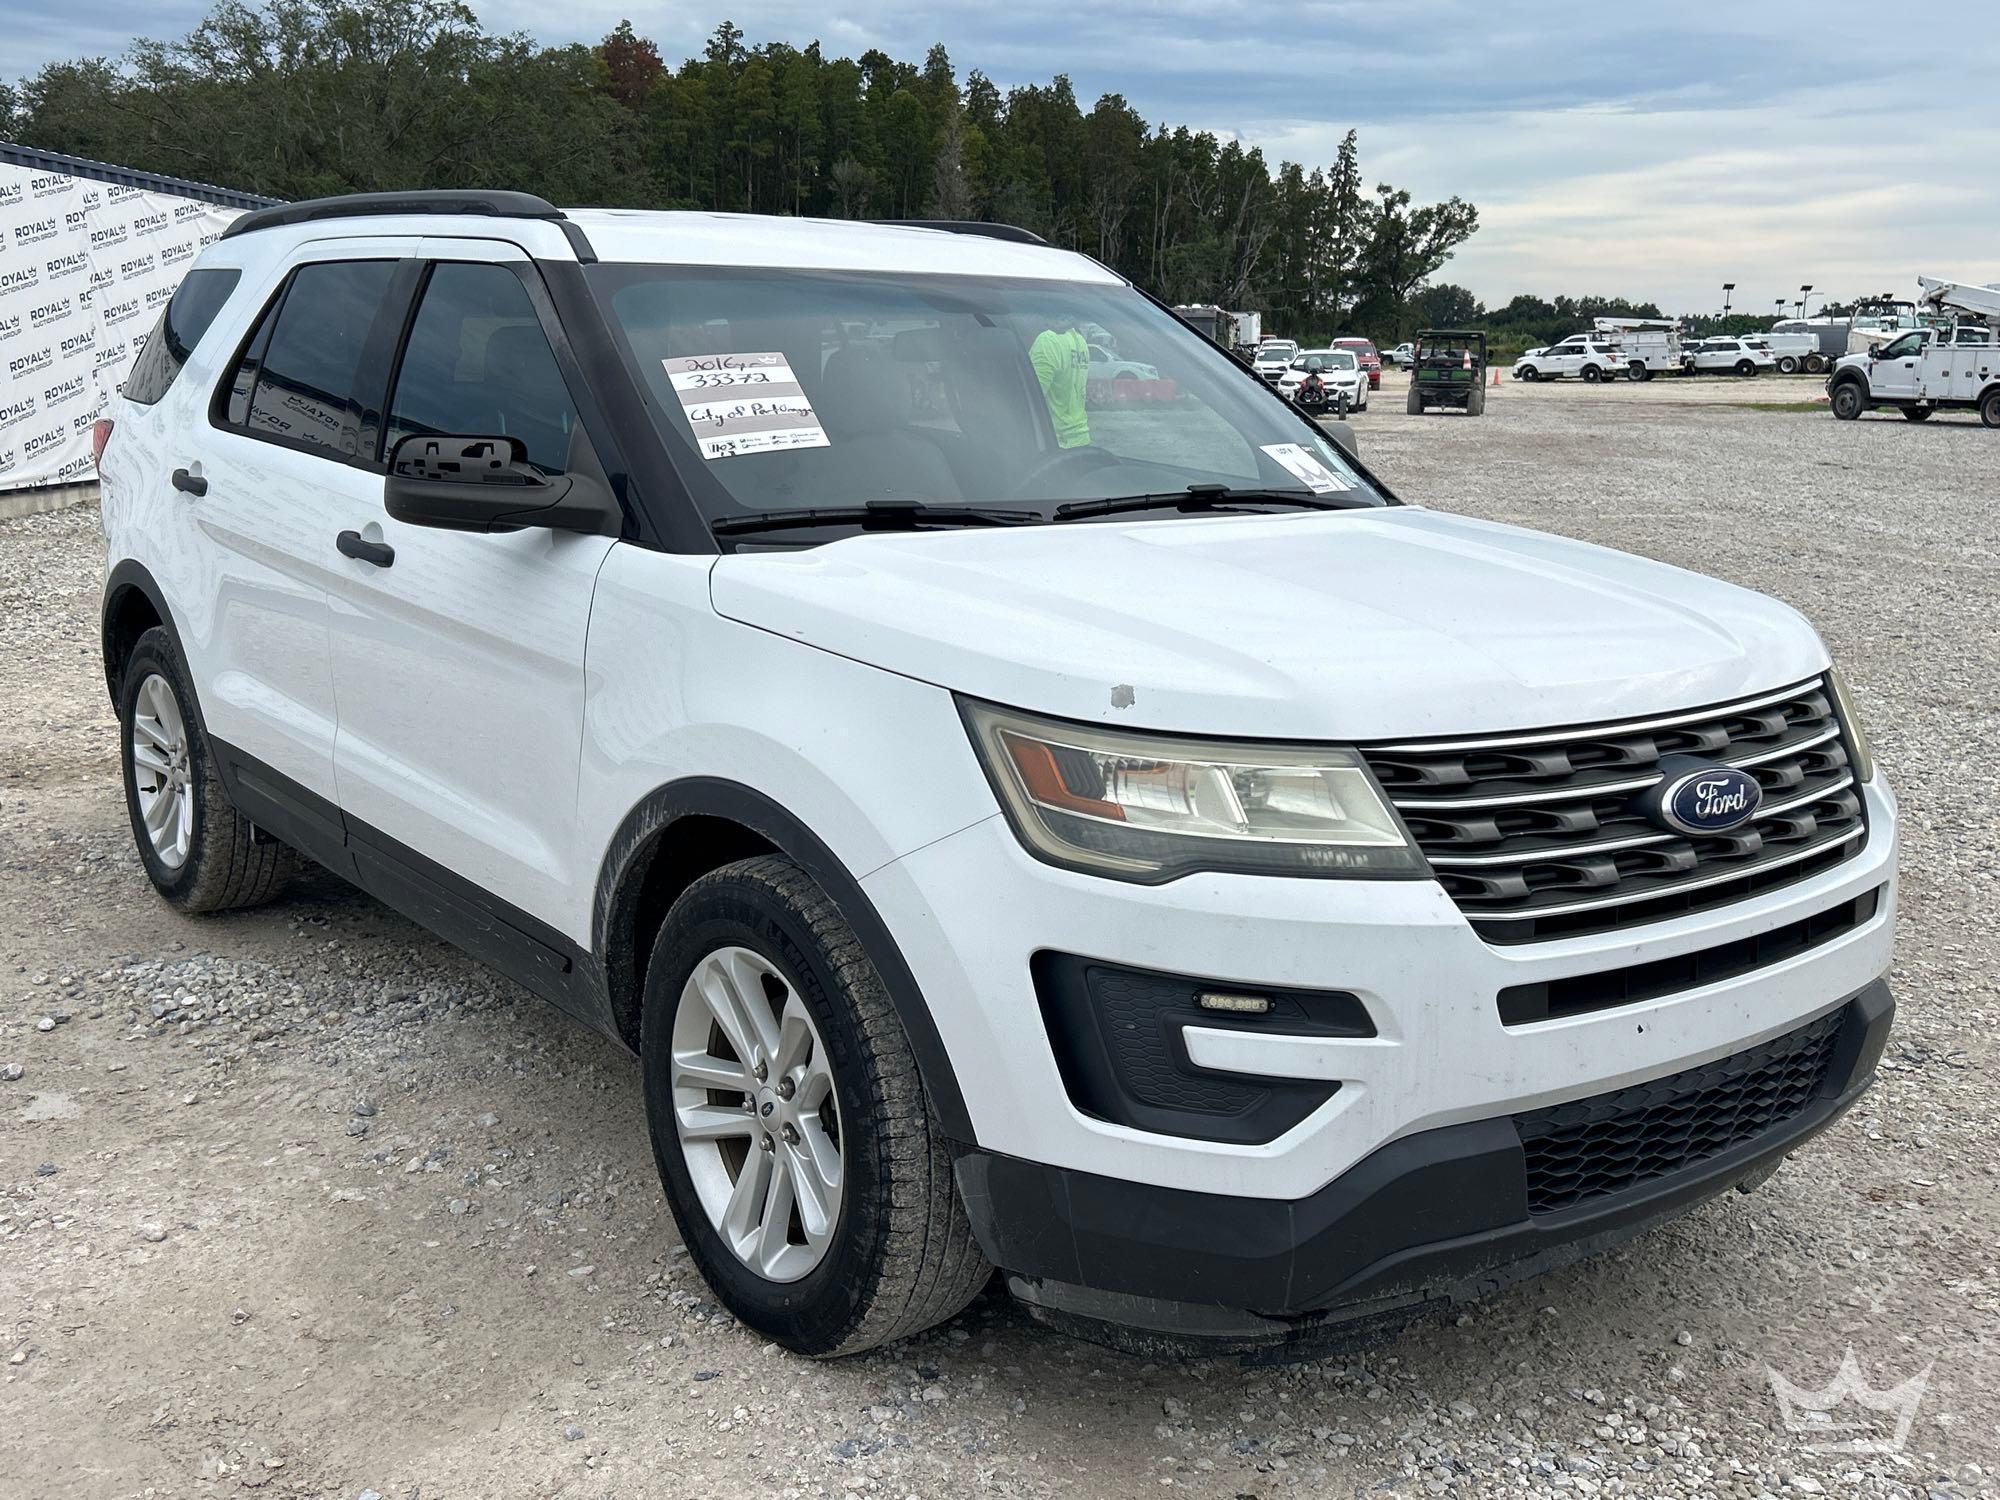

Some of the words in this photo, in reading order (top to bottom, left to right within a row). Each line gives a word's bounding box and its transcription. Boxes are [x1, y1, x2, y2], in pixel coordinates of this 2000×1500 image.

[31, 174, 64, 190] ROYAL
[34, 189, 56, 198] AUCTION
[110, 197, 129, 205] AUCTION
[66, 210, 86, 224] ROY
[174, 204, 199, 218] ROYAL
[68, 223, 87, 232] AUCTIO
[134, 214, 161, 229] ROYAL
[15, 221, 48, 238] ROYAL
[91, 226, 120, 243] ROYAL
[136, 228, 154, 237] AUCTION
[18, 236, 40, 247] AUCTION
[93, 240, 113, 250] AUCTION
[162, 244, 186, 260] ROYAL
[47, 254, 78, 272] ROYAL
[121, 257, 147, 274] ROYAL
[0, 270, 29, 288] OYAL
[50, 270, 70, 280] AUCTION
[90, 271, 106, 284] YAL
[123, 271, 141, 280] AUCTION
[0, 284, 20, 296] UCTION
[146, 288, 172, 303] ROYAL
[30, 302, 63, 321] ROYAL
[104, 302, 132, 320] ROYAL
[33, 317, 55, 328] AUCTION
[106, 316, 125, 327] AUCTION
[61, 332, 92, 352] ROYAL
[133, 332, 149, 348] ROY
[64, 348, 83, 359] AUCTION
[85, 342, 96, 351] GRO
[96, 347, 118, 363] OYAL
[10, 352, 43, 372] ROYAL
[13, 367, 35, 380] AUCTION
[687, 372, 770, 388] 33372
[45, 379, 76, 401] ROYAL
[47, 395, 68, 408] AUCTION
[0, 402, 26, 420] OYAL
[691, 408, 724, 427] City
[728, 406, 745, 418] of
[77, 423, 94, 436] AUCTIO
[24, 431, 57, 453] ROYAL
[27, 447, 48, 461] AUCTION
[58, 456, 89, 478] ROYAL
[65, 471, 81, 482] CTION
[1696, 779, 1747, 819] Ford
